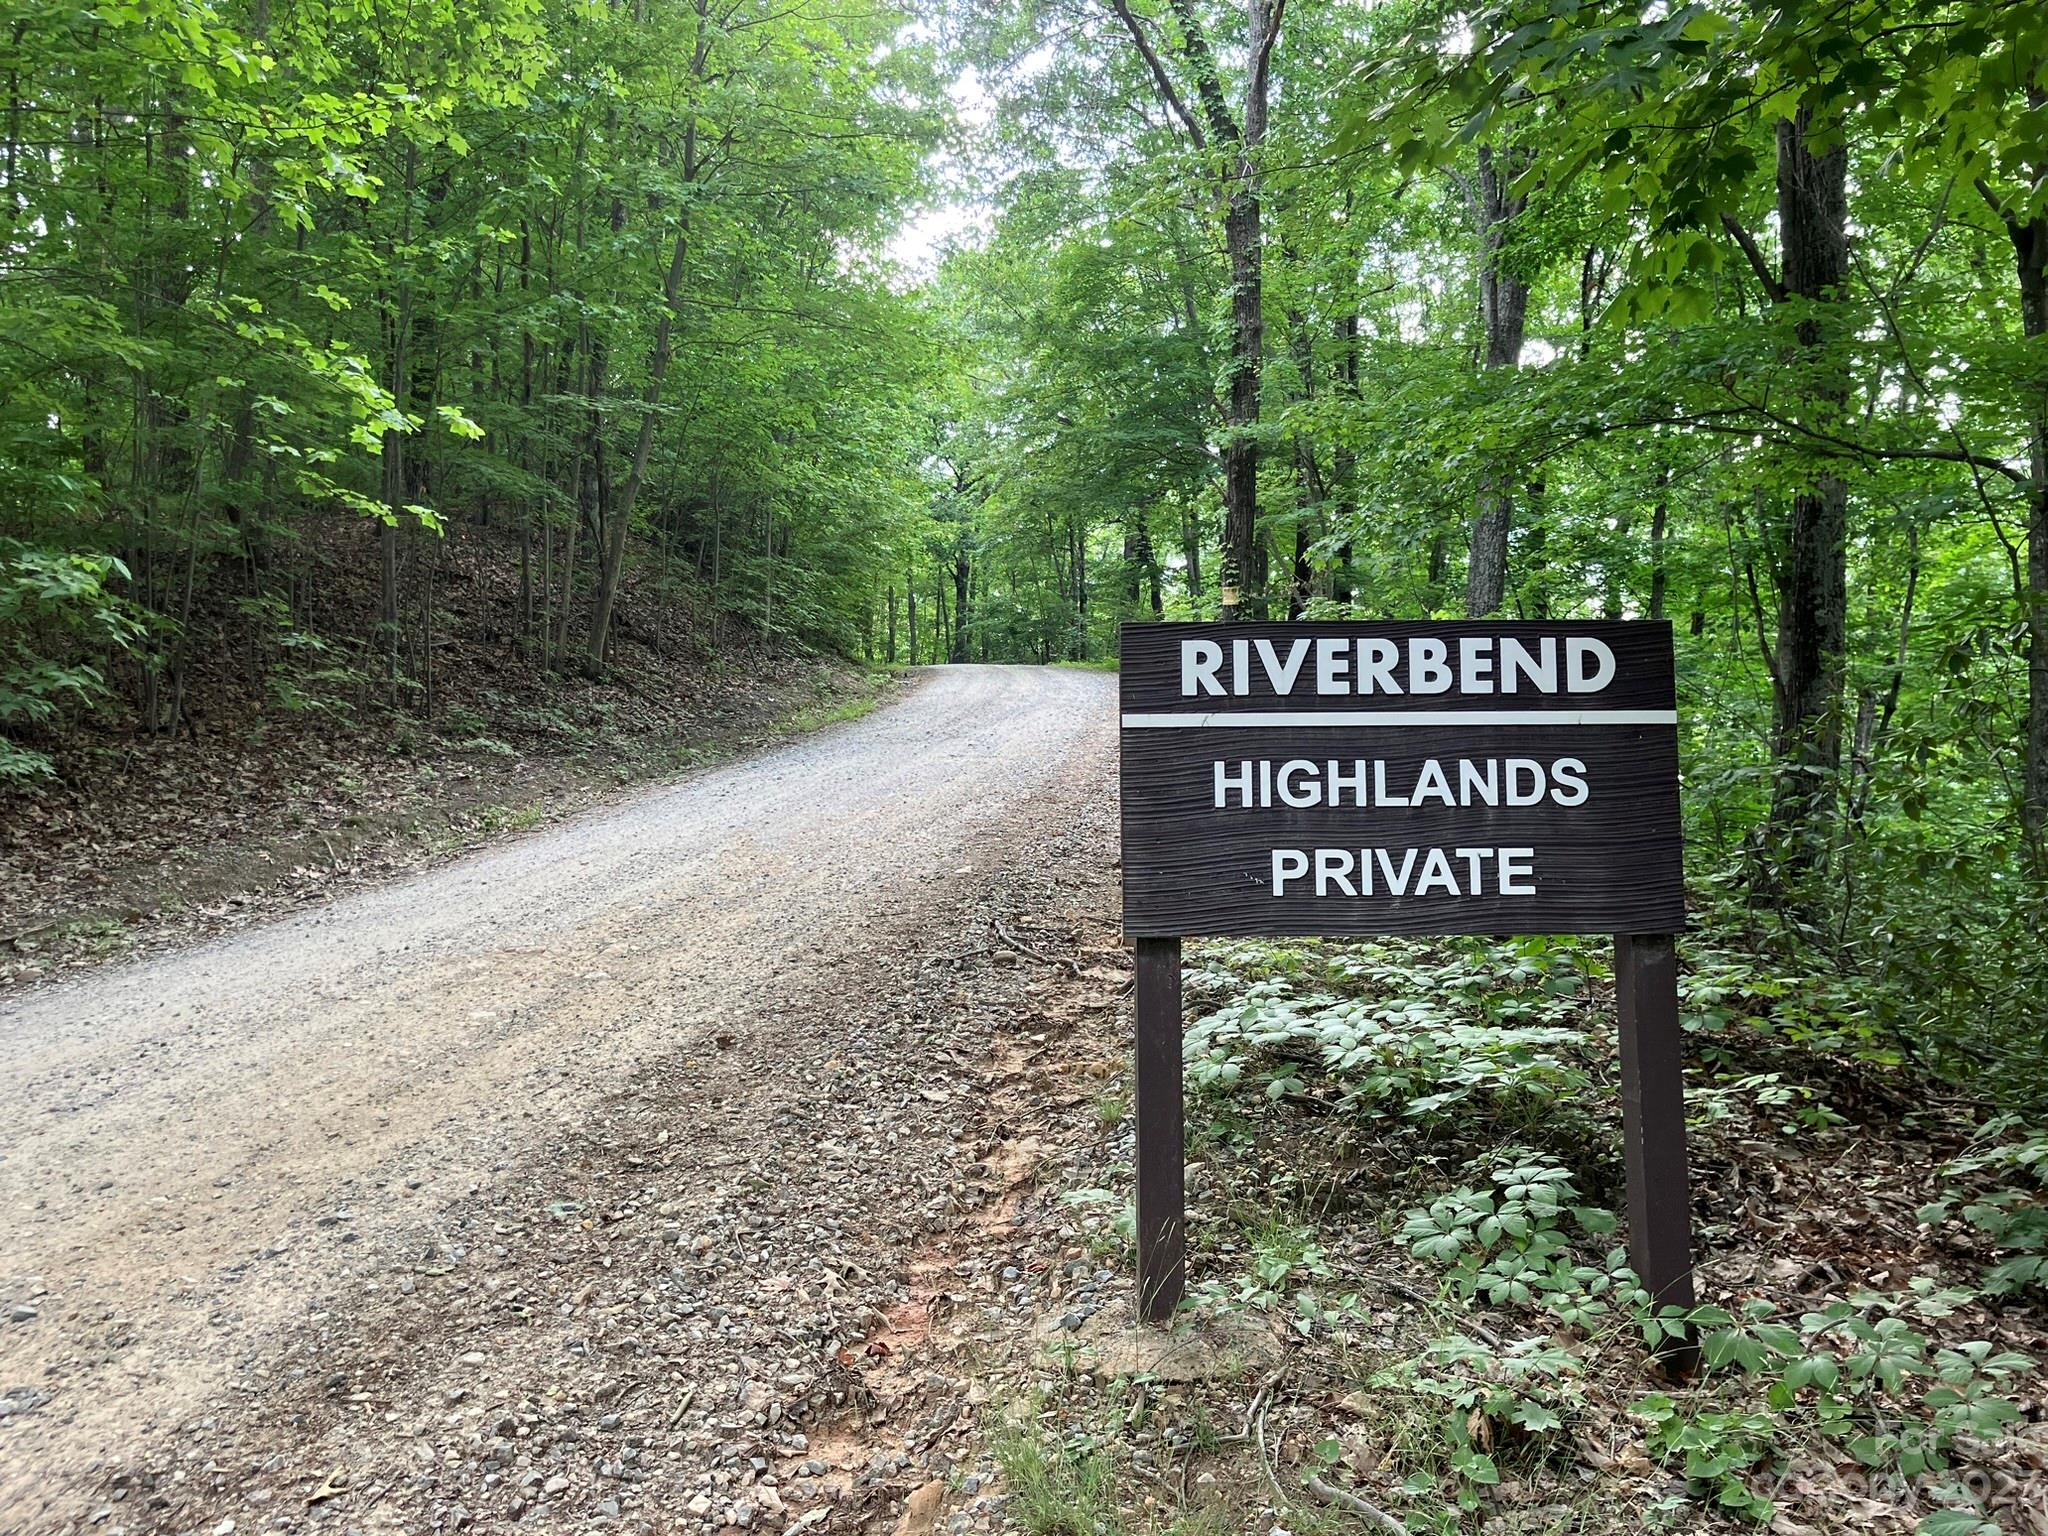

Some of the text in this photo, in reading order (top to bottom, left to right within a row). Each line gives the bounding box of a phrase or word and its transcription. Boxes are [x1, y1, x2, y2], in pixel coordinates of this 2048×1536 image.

[1181, 637, 1616, 696] RIVERBEND
[1214, 758, 1588, 807] HIGHLANDS
[1272, 848, 1535, 896] PRIVATE
